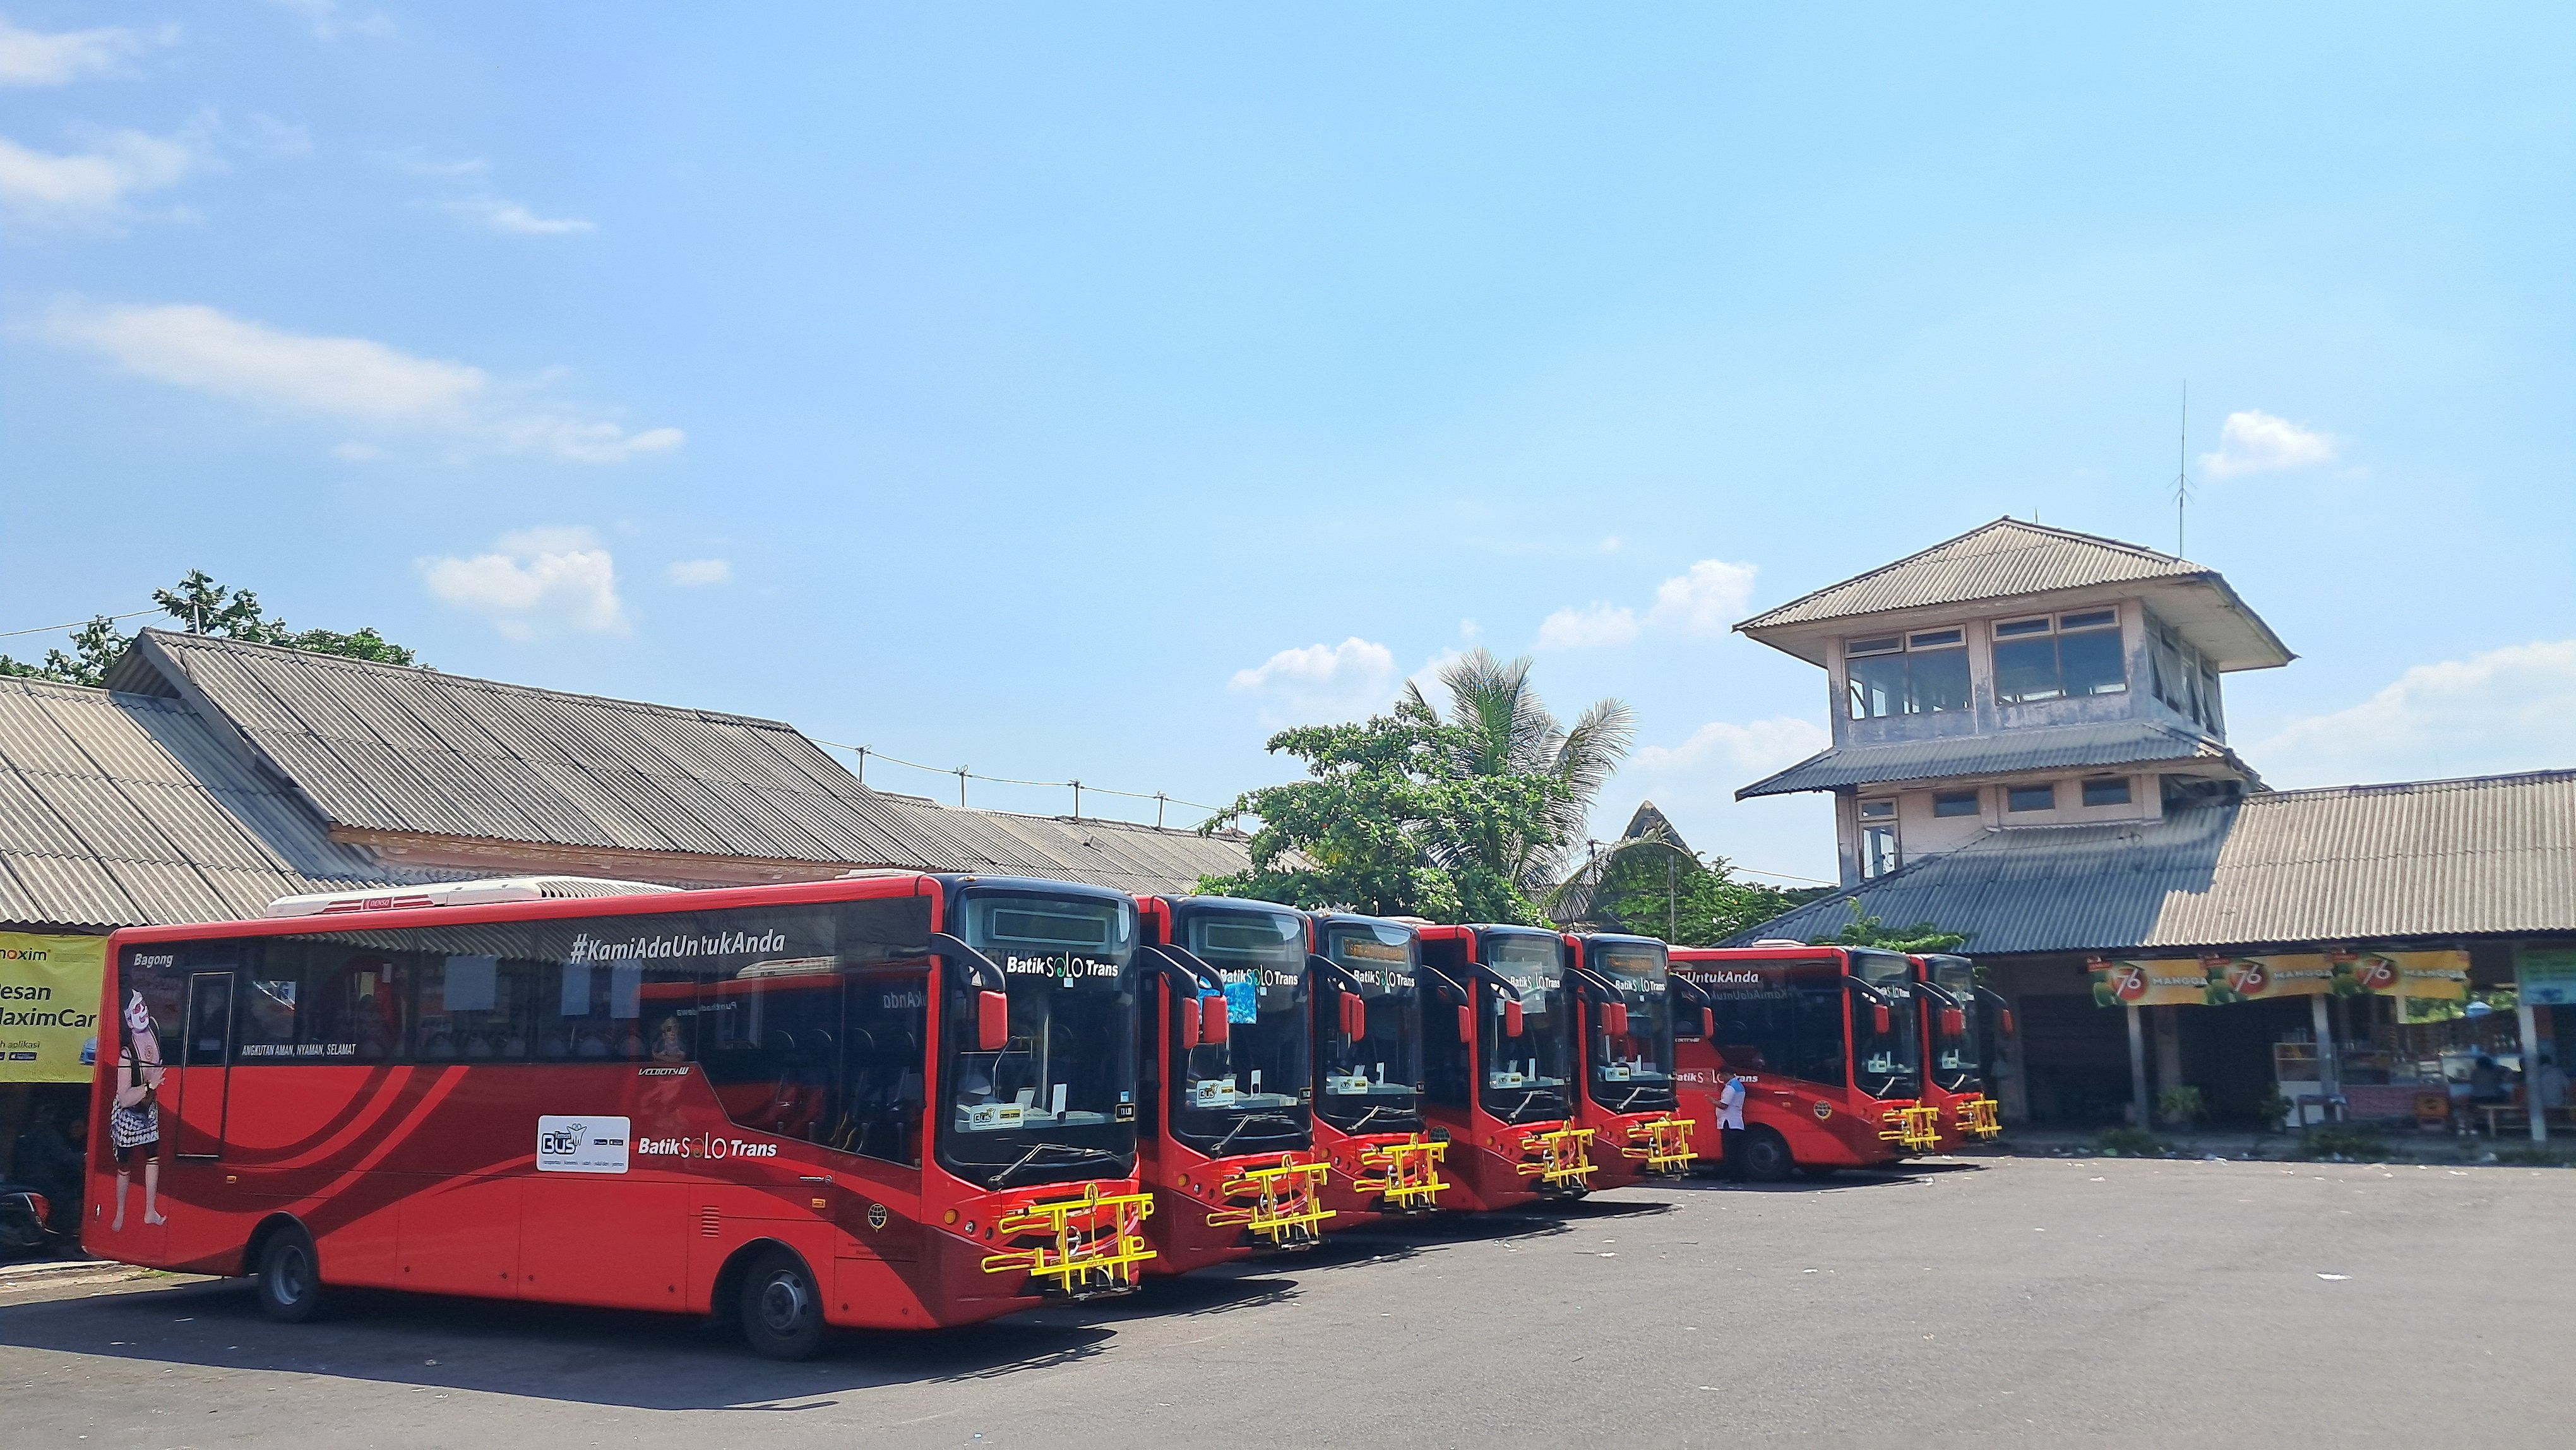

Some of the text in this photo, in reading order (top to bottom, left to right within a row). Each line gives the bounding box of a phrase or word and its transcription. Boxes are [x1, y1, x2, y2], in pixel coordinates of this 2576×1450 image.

[570, 928, 787, 964] #KamiAdaUntukAnda
[133, 953, 174, 968] Bagong
[1085, 959, 1119, 977] Trans
[1274, 971, 1299, 986] Trans
[1396, 973, 1415, 987] Trans
[0, 983, 52, 1000] esan
[242, 1045, 274, 1056] ANGKUTAN
[326, 1043, 357, 1055] SELAMAT
[1677, 1072, 1697, 1082] atik
[1733, 1073, 1758, 1082] rans
[638, 1137, 680, 1155] Batik
[730, 1139, 778, 1157] Trans
